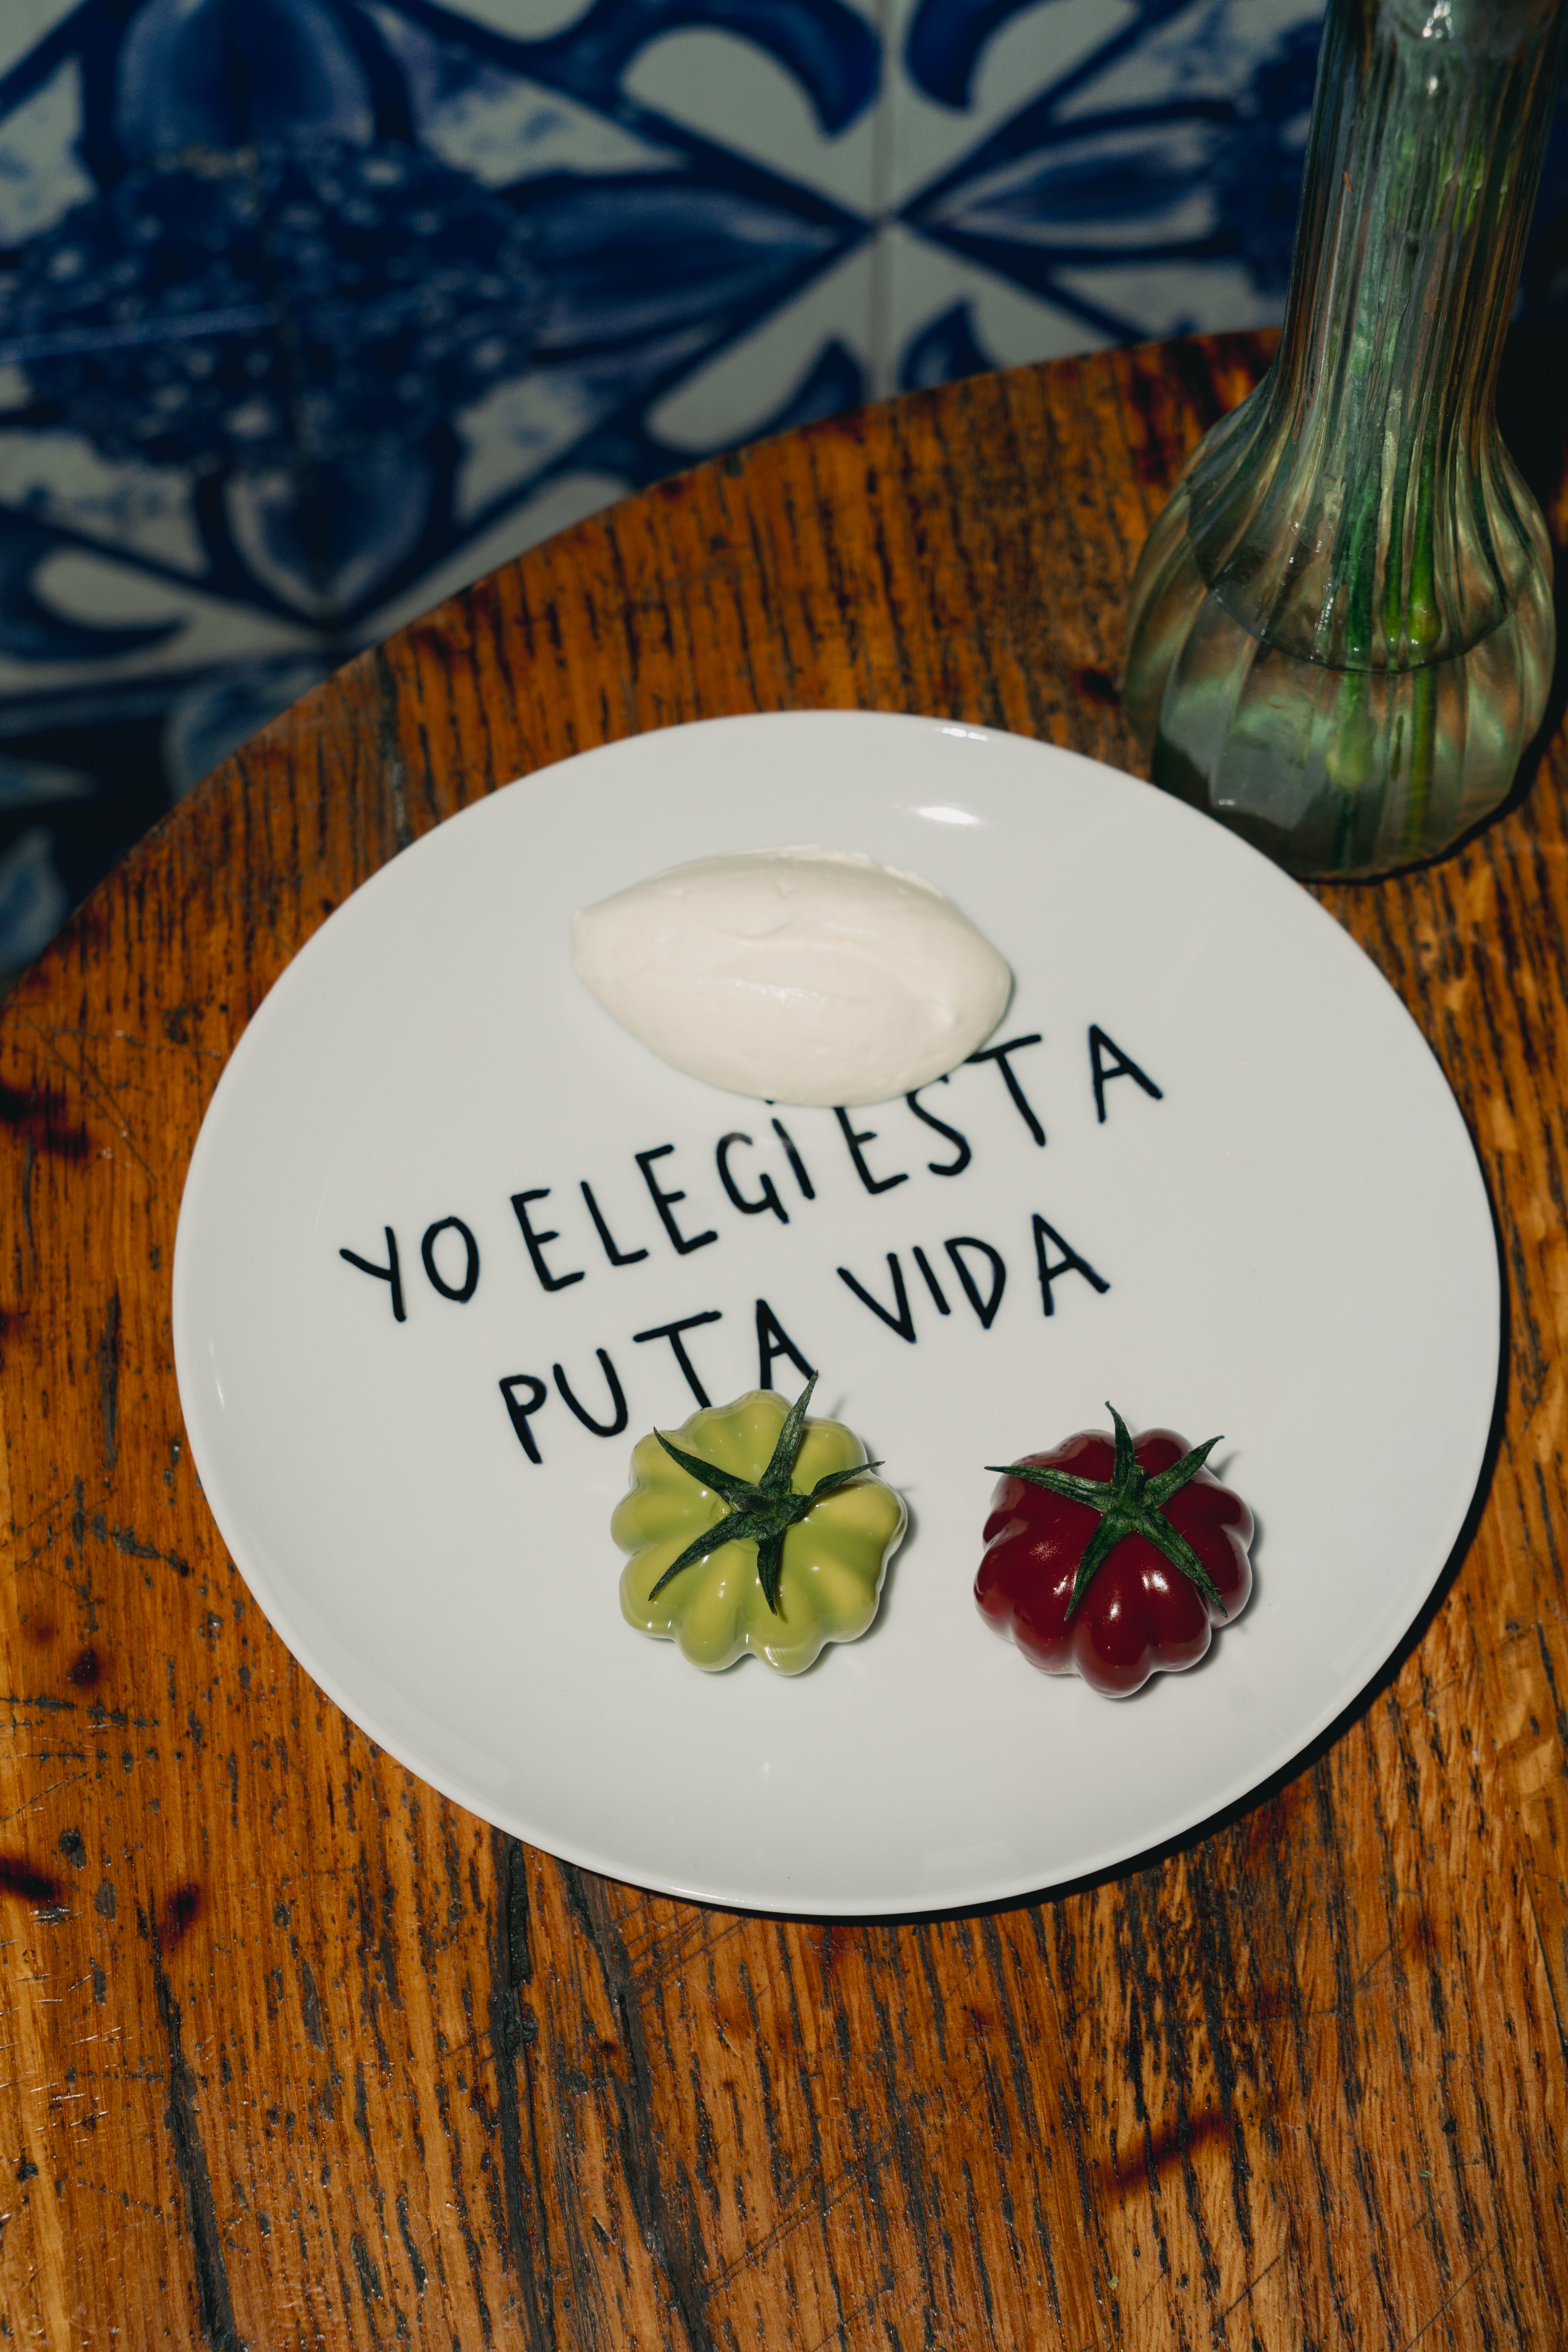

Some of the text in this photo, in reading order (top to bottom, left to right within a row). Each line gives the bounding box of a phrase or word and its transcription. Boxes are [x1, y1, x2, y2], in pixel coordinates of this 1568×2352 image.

[339, 1216, 480, 1323] YO
[832, 1024, 1163, 1195] ESTA
[499, 1213, 1111, 1465] PUTA VIDA
